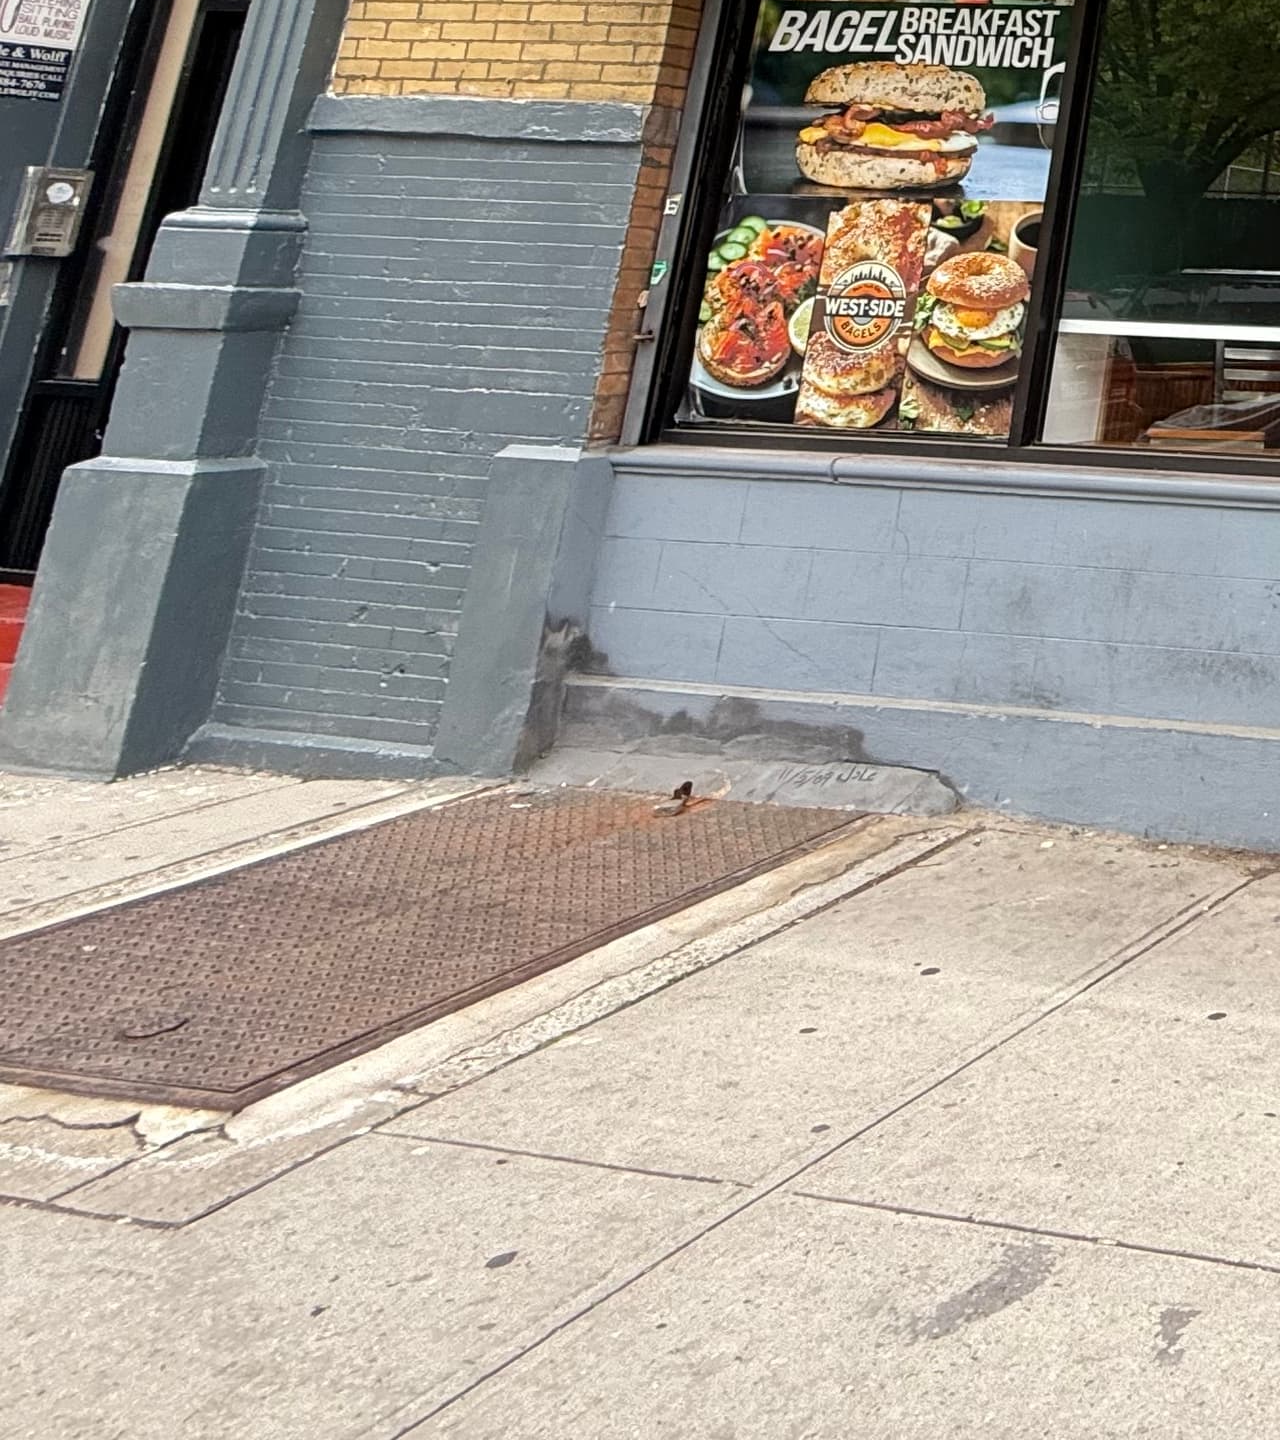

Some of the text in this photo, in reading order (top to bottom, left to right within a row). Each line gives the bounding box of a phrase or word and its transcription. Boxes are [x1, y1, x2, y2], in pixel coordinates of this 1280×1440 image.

[21, 2, 78, 20] SITTING
[15, 24, 40, 37] LOUD
[768, 7, 1061, 53] BAGEL BREAKFAST
[11, 46, 26, 58] &
[30, 48, 70, 62] Wolff
[894, 33, 1056, 68] SANDWICH
[841, 320, 882, 338] BAGELS
